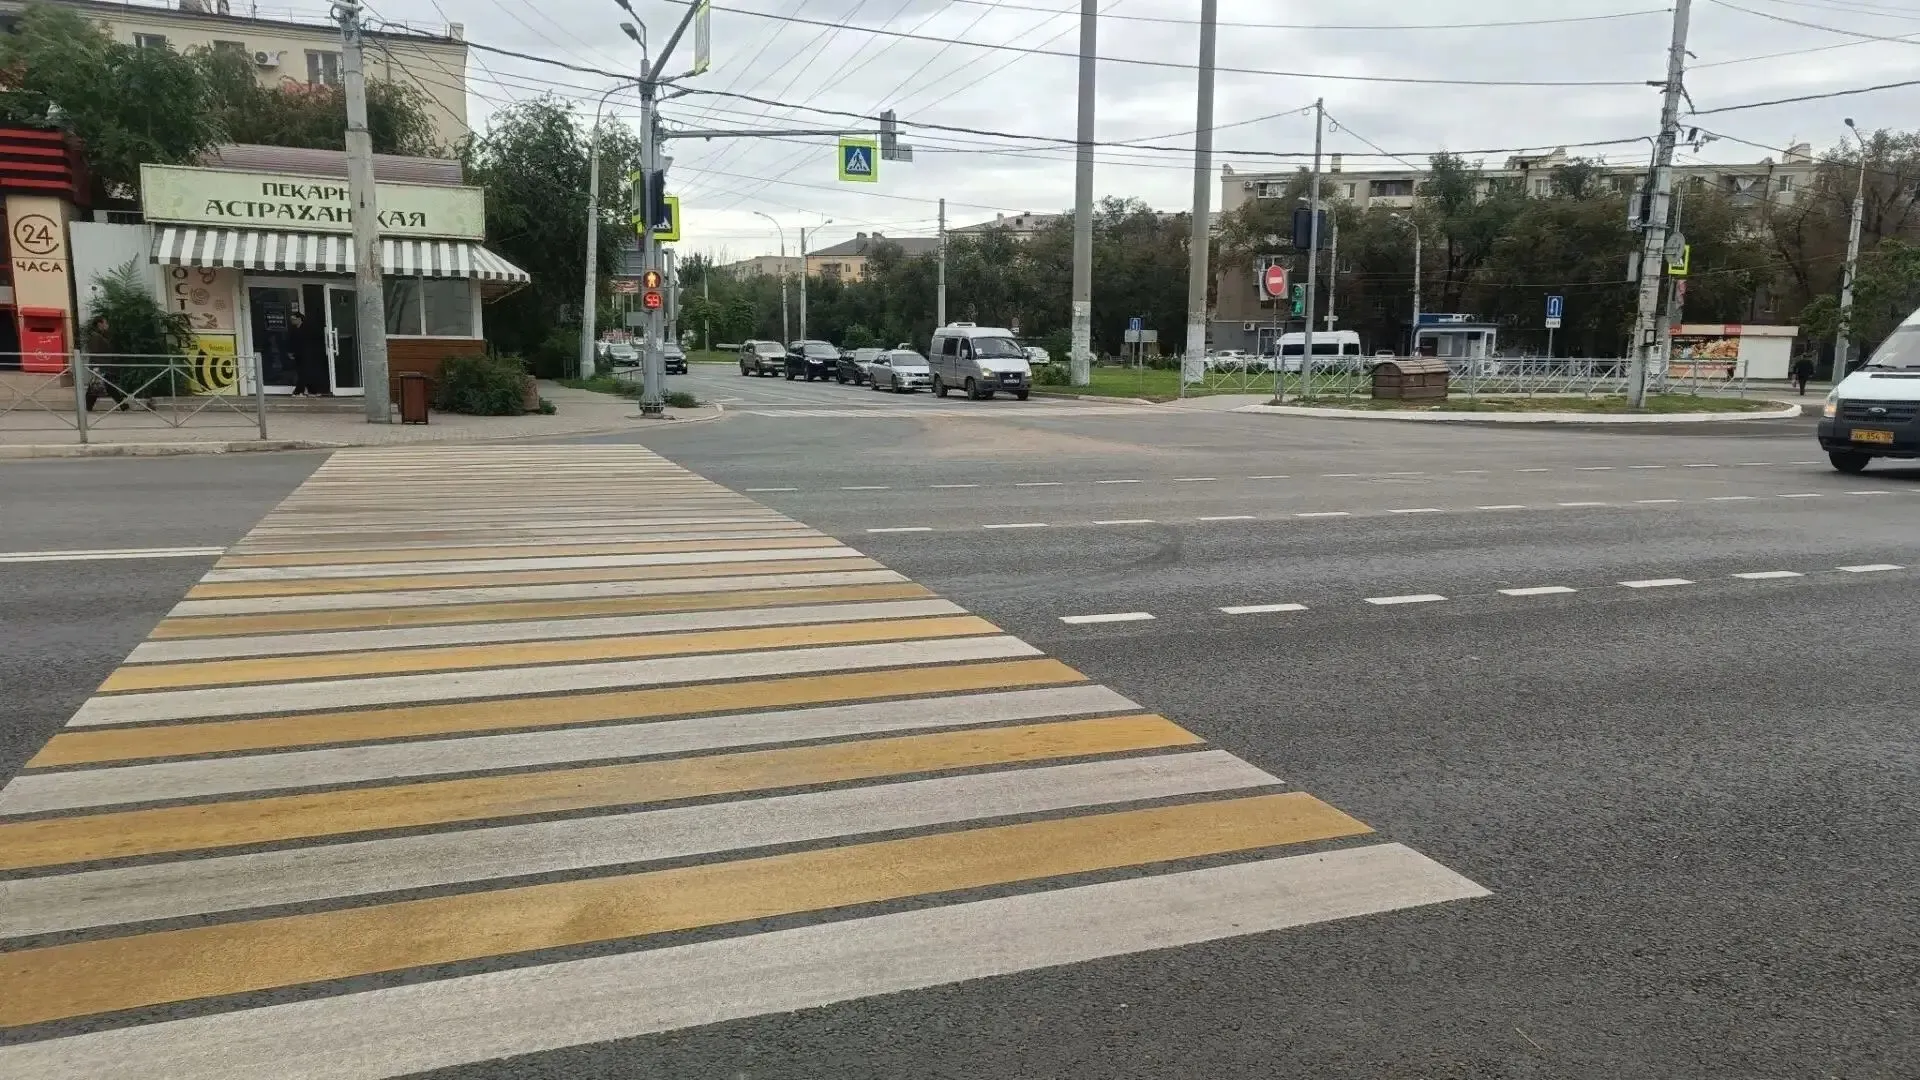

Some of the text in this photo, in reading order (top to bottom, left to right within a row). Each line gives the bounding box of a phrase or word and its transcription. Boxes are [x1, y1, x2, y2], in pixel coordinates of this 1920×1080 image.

[262, 182, 350, 200] ПЕКАРН
[205, 199, 426, 228] АСТРАХАНКАЯ
[22, 224, 53, 246] 24
[16, 261, 63, 272] ЧАСА
